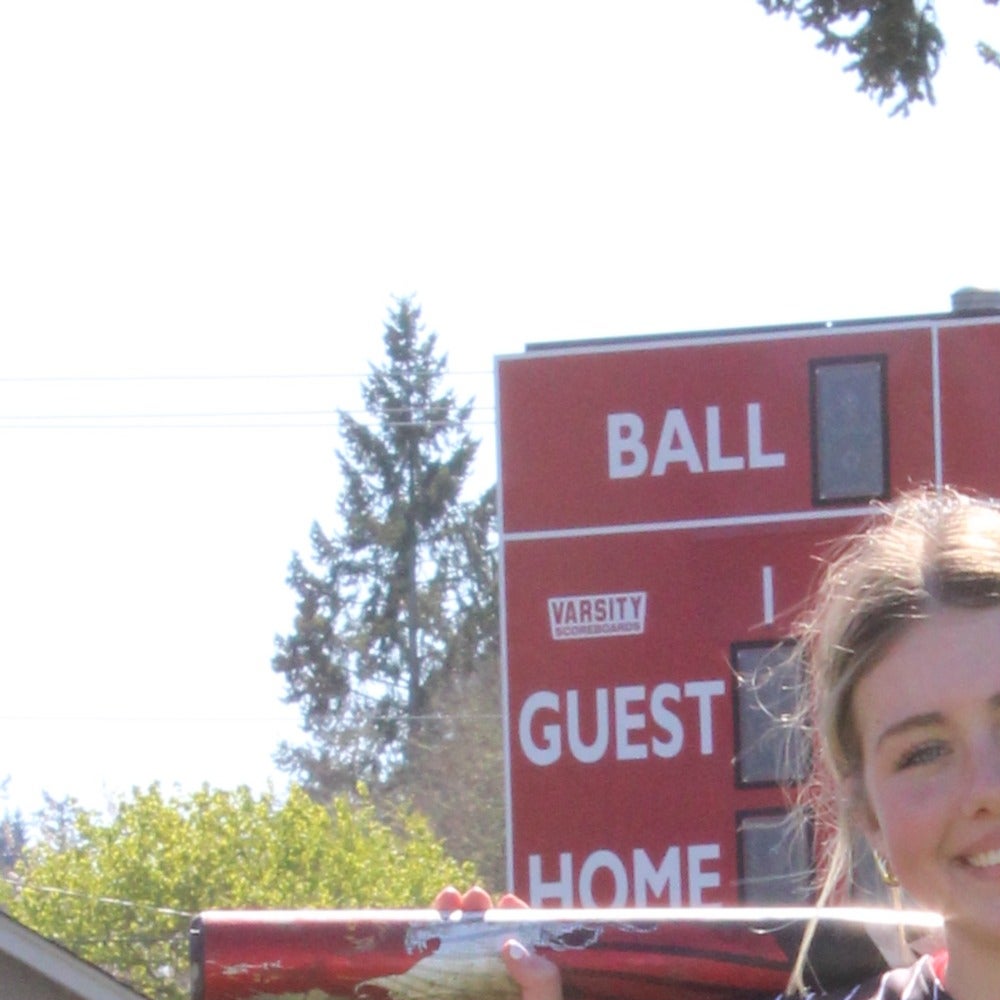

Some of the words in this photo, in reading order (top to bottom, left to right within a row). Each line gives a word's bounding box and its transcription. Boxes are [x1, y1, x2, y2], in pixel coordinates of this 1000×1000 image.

[606, 402, 785, 480] BALL
[551, 596, 642, 624] VARSITY
[555, 621, 641, 637] SCOREBOARDS
[518, 679, 726, 767] GUEST
[528, 843, 723, 908] HOME
